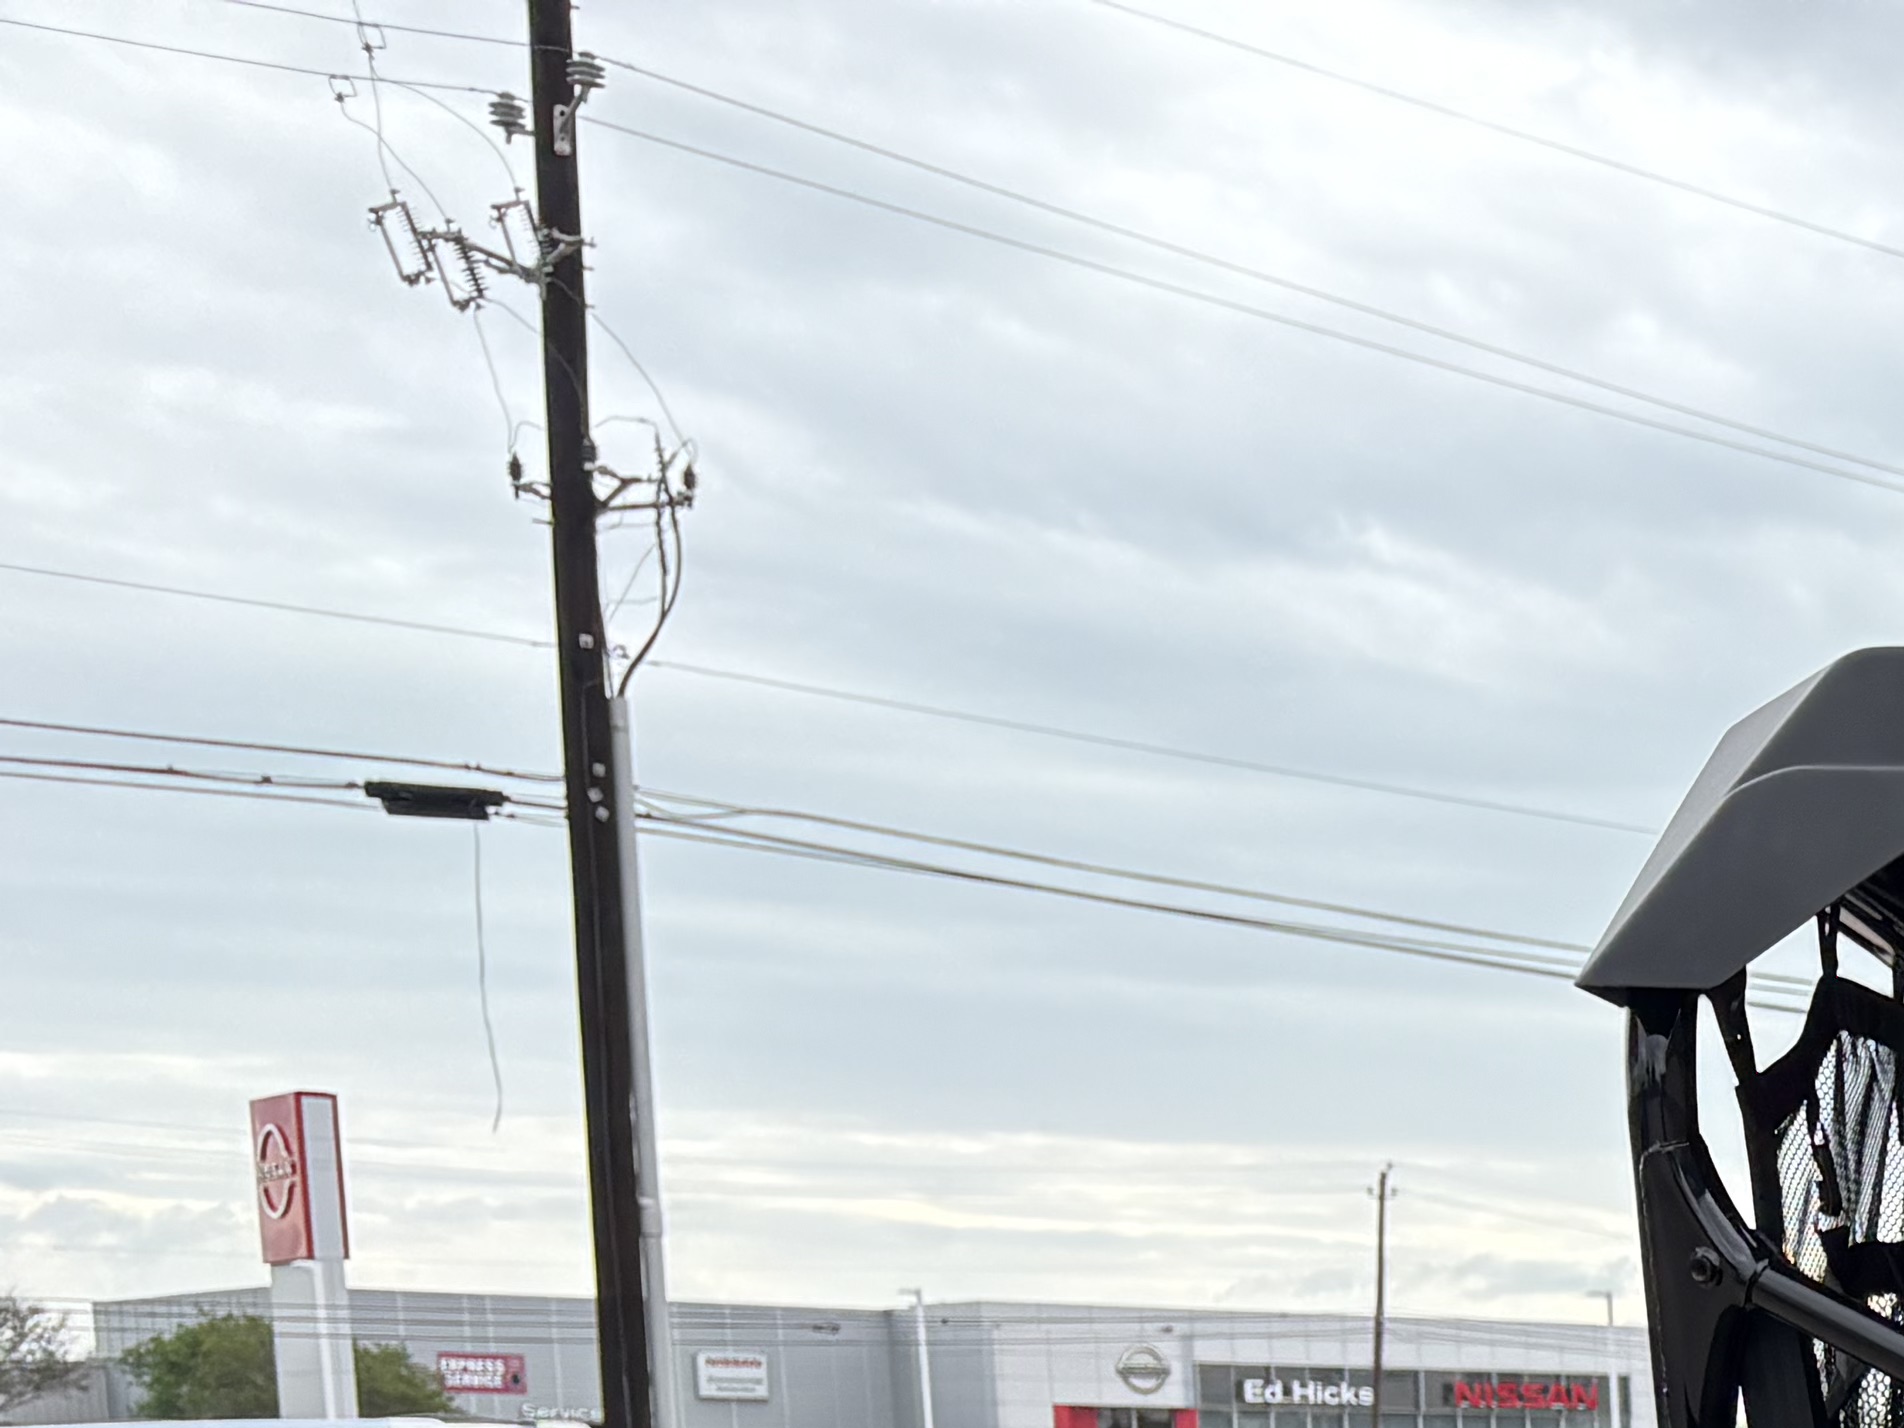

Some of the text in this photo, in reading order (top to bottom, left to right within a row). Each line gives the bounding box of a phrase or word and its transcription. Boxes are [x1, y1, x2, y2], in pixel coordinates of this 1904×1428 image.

[1243, 1379, 1375, 1406] Ed Hicks
[1455, 1380, 1598, 1411] NISSAN
[522, 1402, 602, 1420] Service
